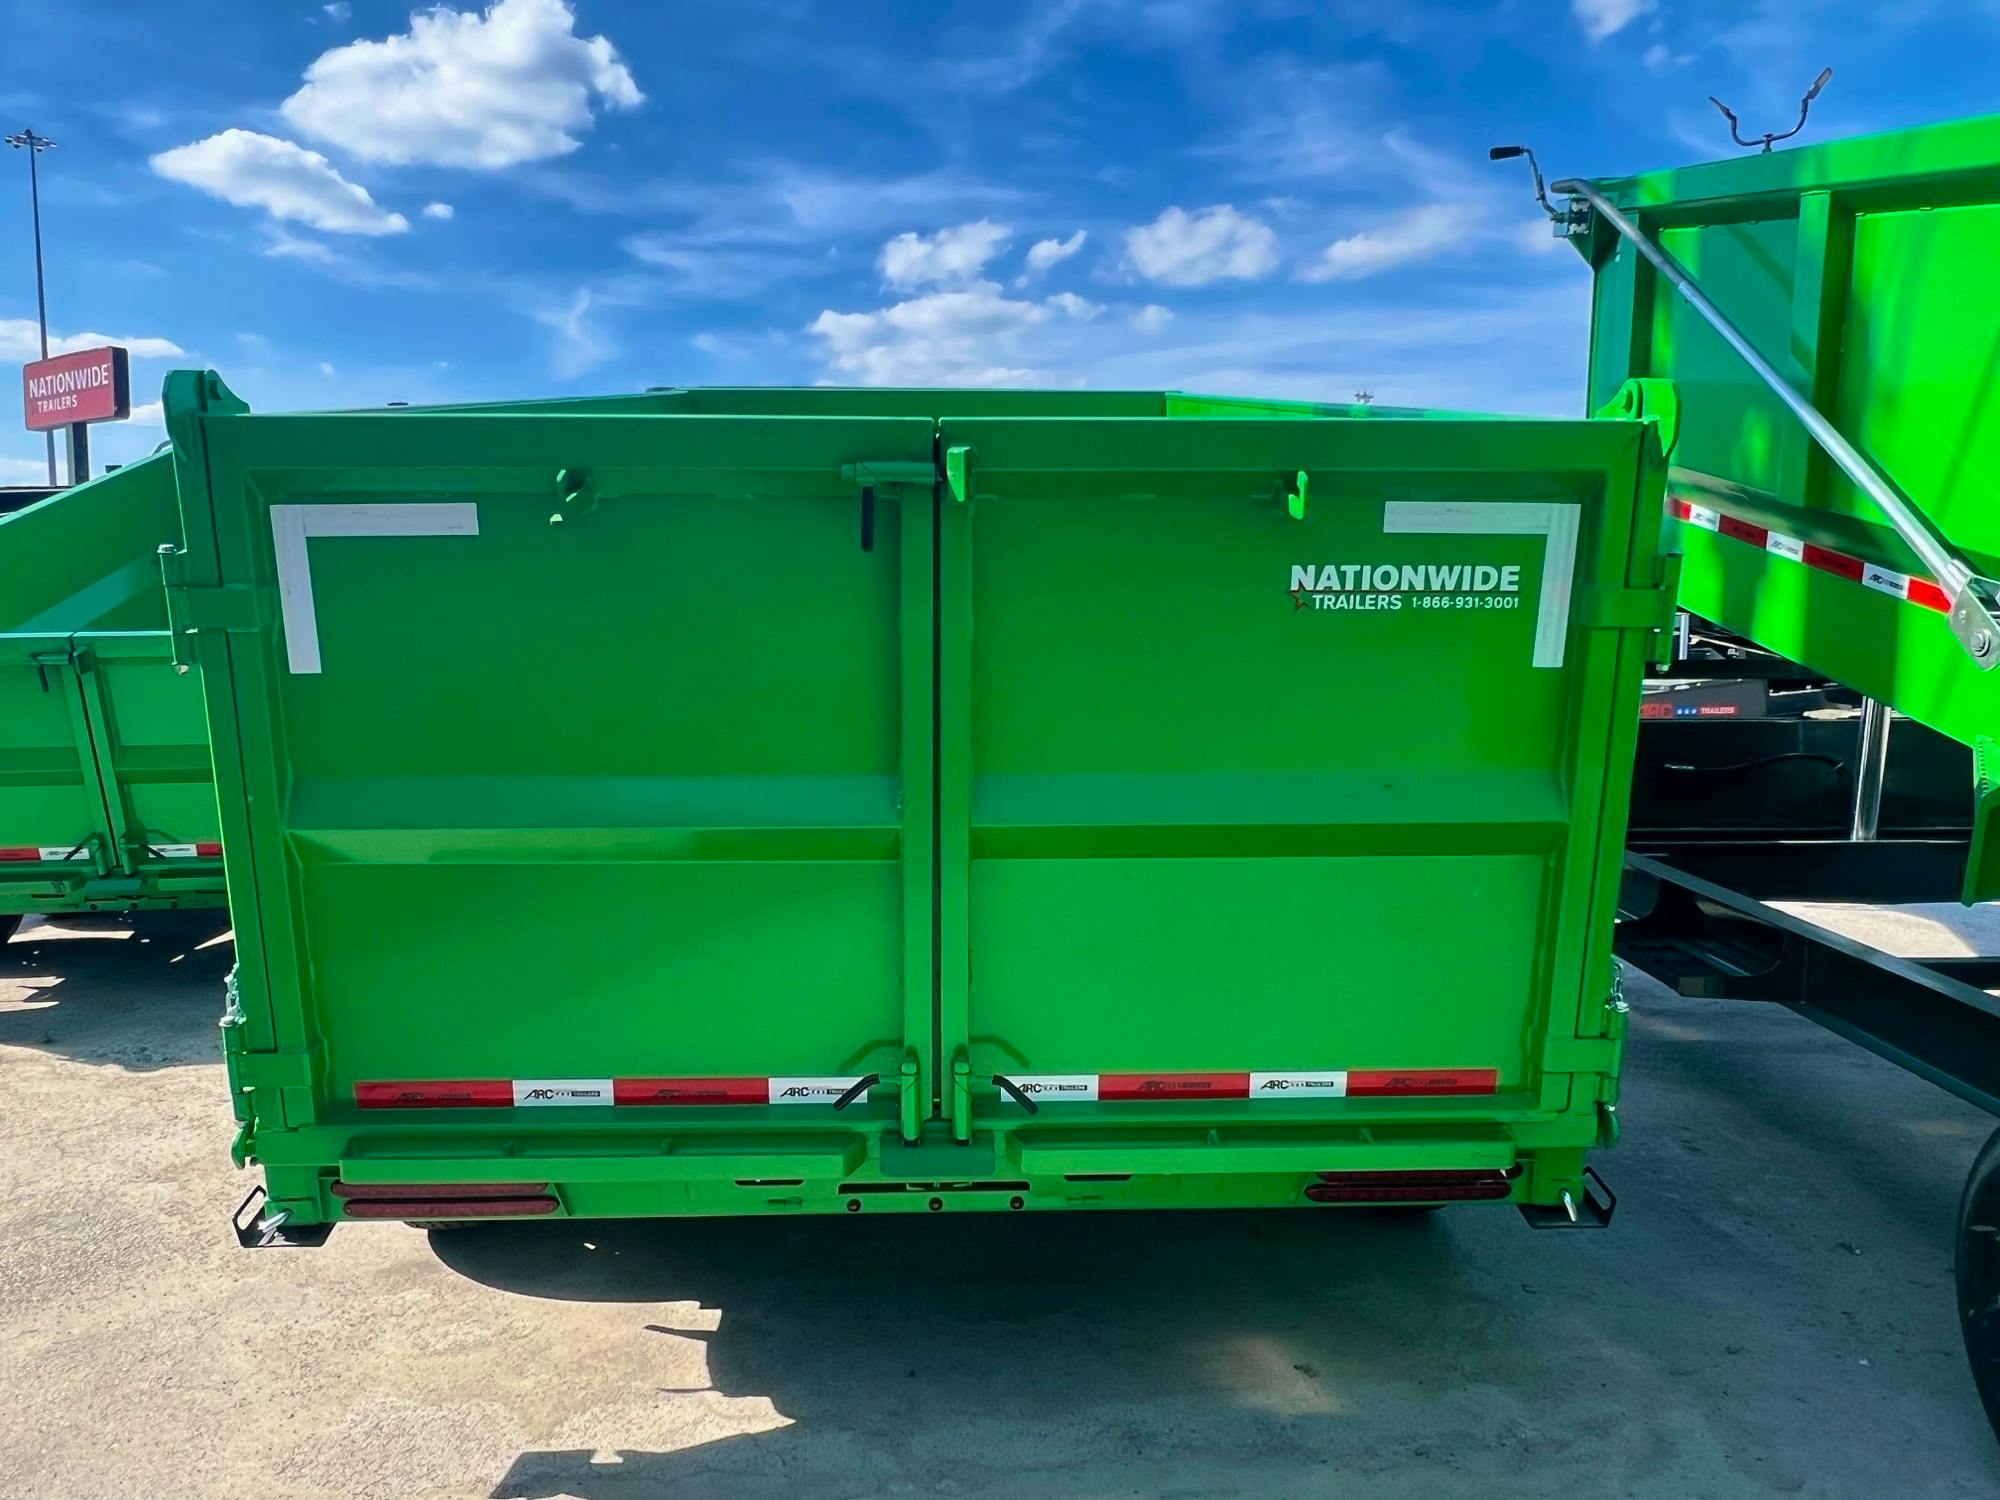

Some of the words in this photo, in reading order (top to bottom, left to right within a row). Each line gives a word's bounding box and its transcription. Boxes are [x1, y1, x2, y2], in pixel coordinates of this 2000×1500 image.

[29, 365, 109, 398] NATIONWIDE
[38, 395, 78, 413] TRAILERS
[1290, 564, 1521, 592] NATIONWIDE
[1312, 594, 1402, 610] TRAILERS
[1412, 596, 1519, 609] 1-866-931-3001
[780, 1087, 810, 1097] ARC
[1260, 1079, 1290, 1090] ARC
[524, 1089, 554, 1100] ARC
